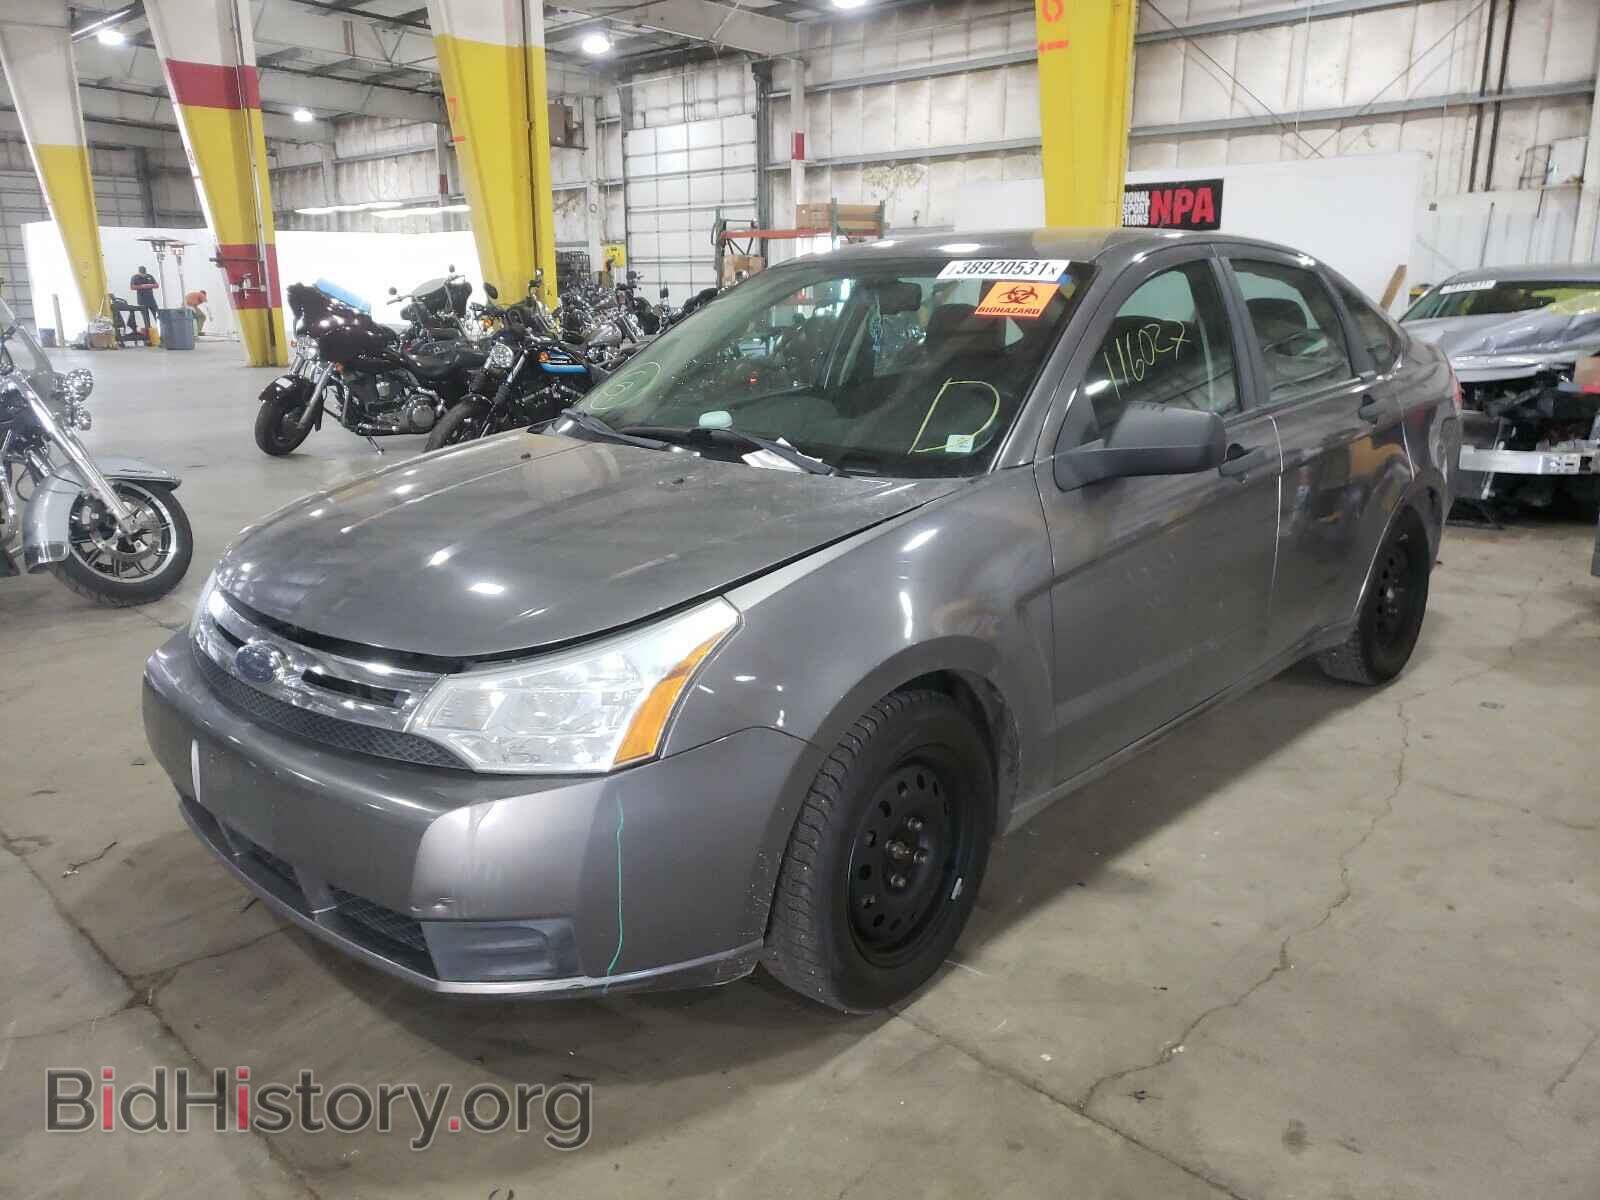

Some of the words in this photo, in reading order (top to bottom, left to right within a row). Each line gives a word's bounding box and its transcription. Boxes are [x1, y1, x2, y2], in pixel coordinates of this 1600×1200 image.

[1151, 187, 1215, 225] NPA
[956, 261, 1049, 275] 38920531
[978, 306, 1041, 315] BIOHAZARD
